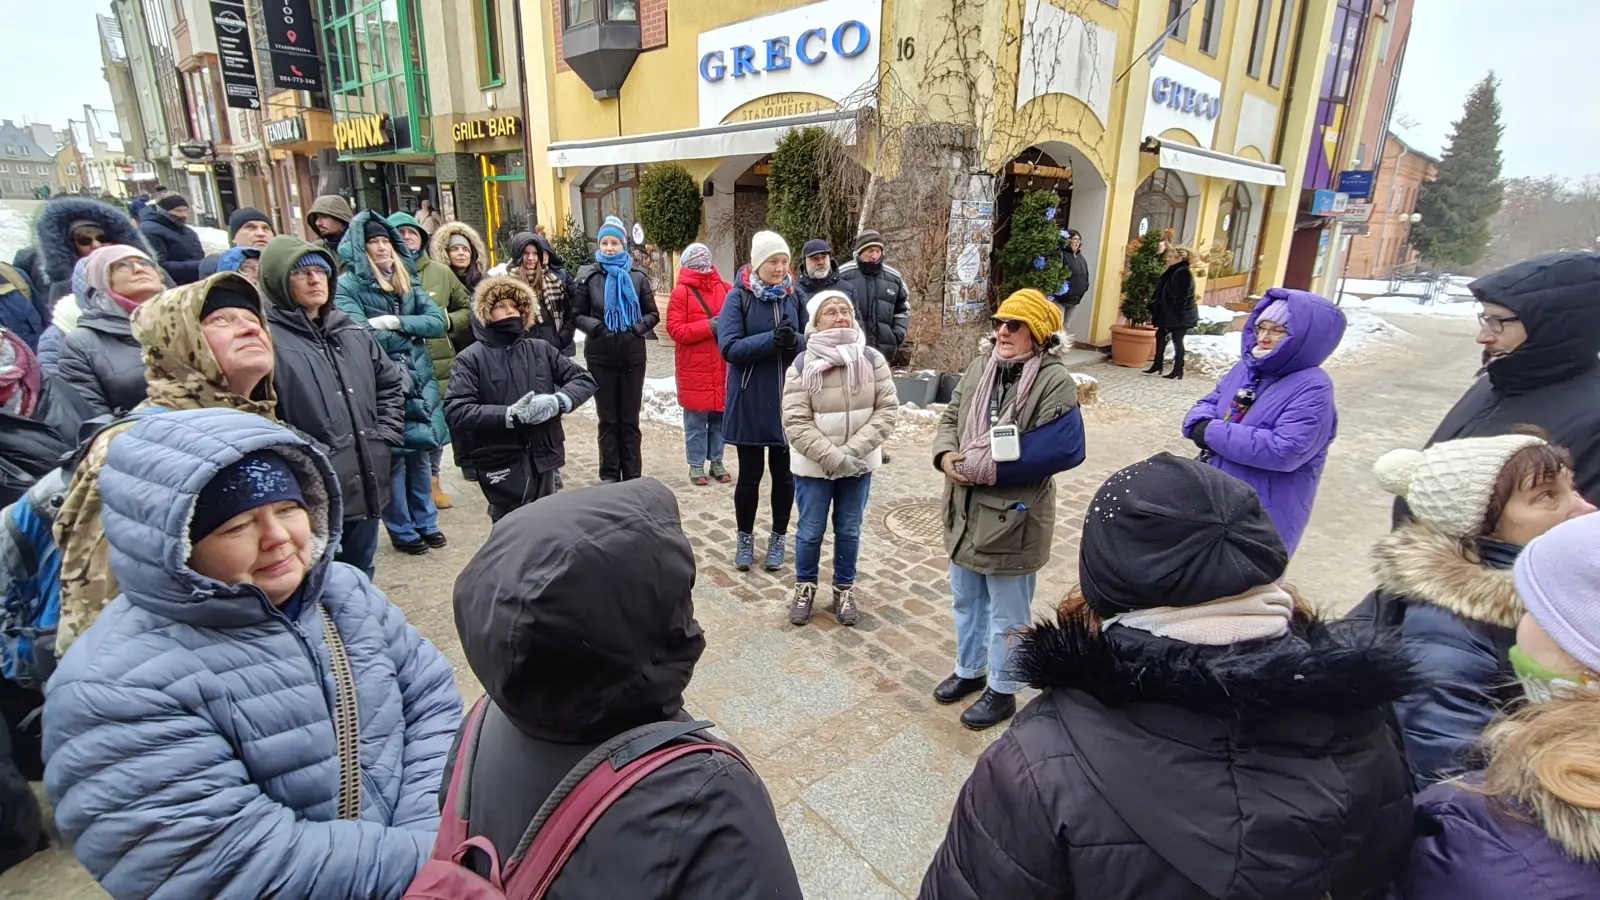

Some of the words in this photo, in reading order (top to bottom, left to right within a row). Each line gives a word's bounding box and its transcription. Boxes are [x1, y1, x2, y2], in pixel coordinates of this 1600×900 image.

[699, 20, 871, 82] GRECO
[896, 36, 915, 62] 16
[764, 93, 794, 106] ULICA
[1152, 76, 1220, 121] GRECO
[333, 113, 384, 151] SPHINX
[452, 120, 485, 142] GRILL
[488, 116, 516, 137] BAR
